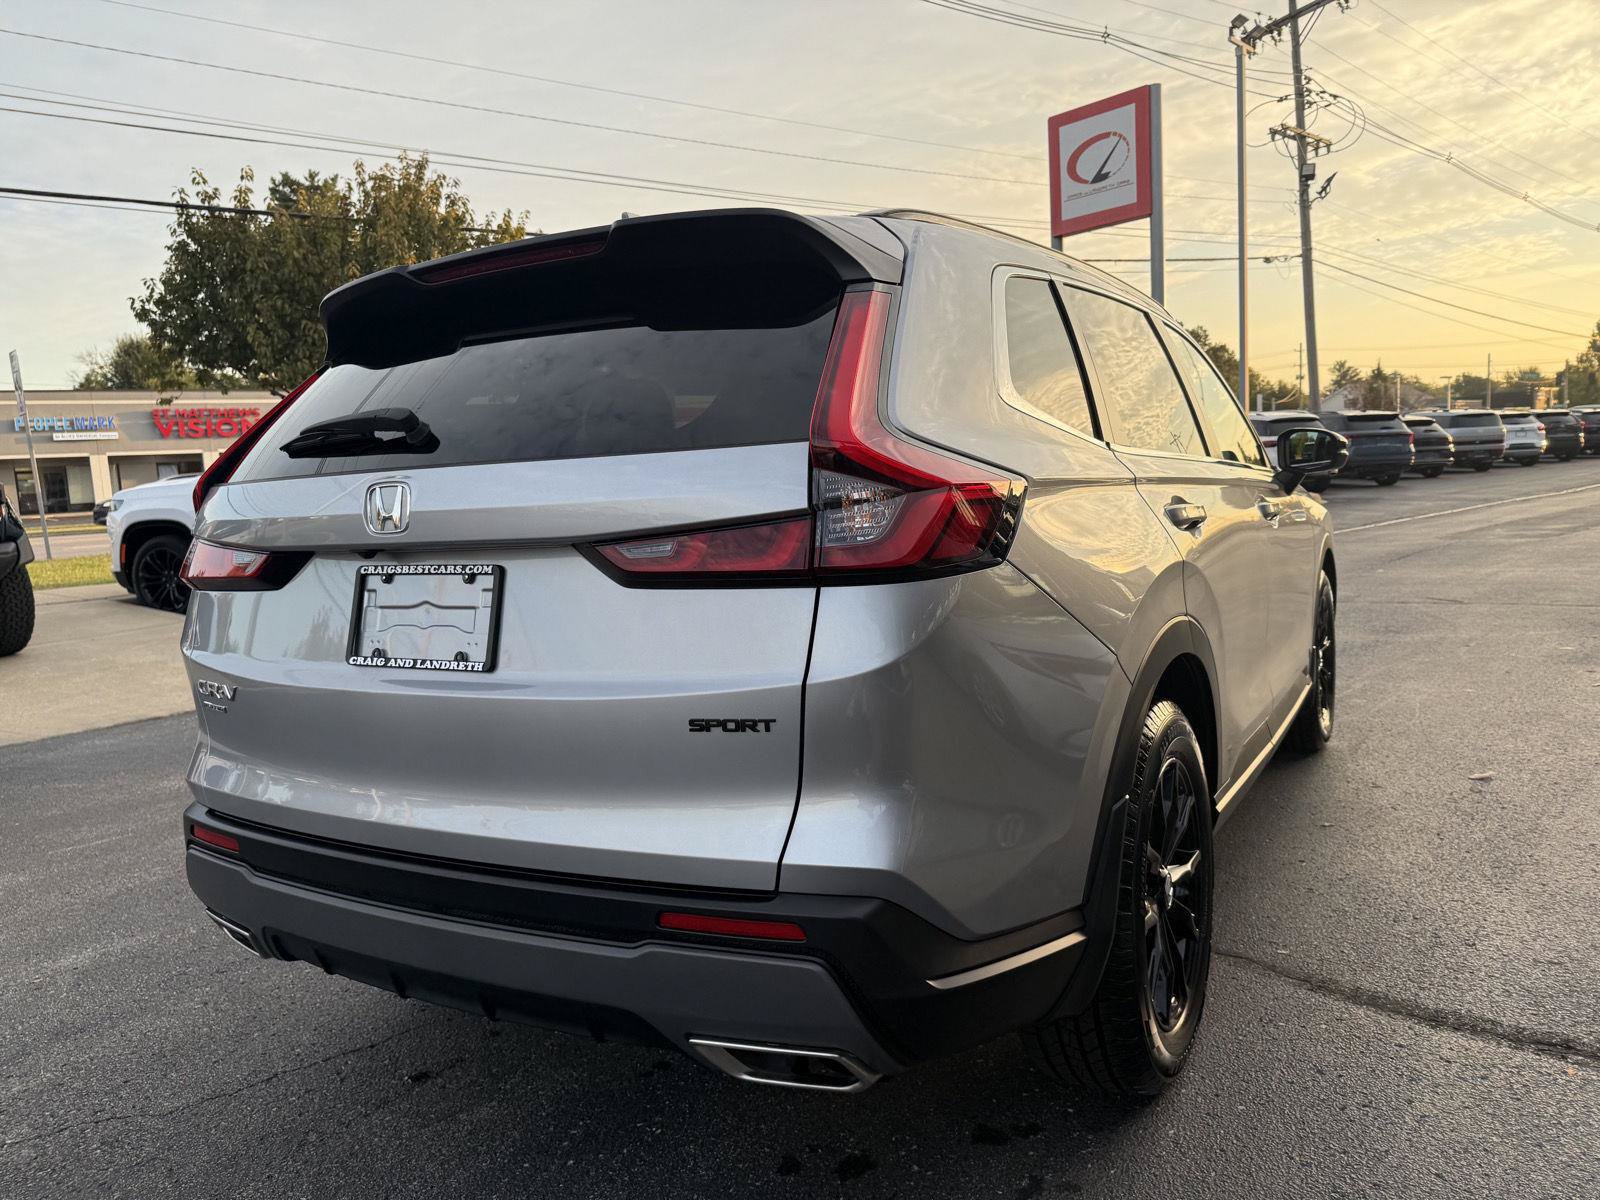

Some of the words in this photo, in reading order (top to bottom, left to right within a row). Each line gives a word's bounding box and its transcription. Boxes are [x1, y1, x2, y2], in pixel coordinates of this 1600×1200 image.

[175, 407, 260, 420] MATTHEWS
[360, 564, 493, 575] CRAIGSBESTCARS.COM
[348, 656, 386, 667] CRAIG
[386, 658, 414, 669] AND
[415, 659, 485, 672] LANDRETH
[688, 718, 777, 733] SPORT
